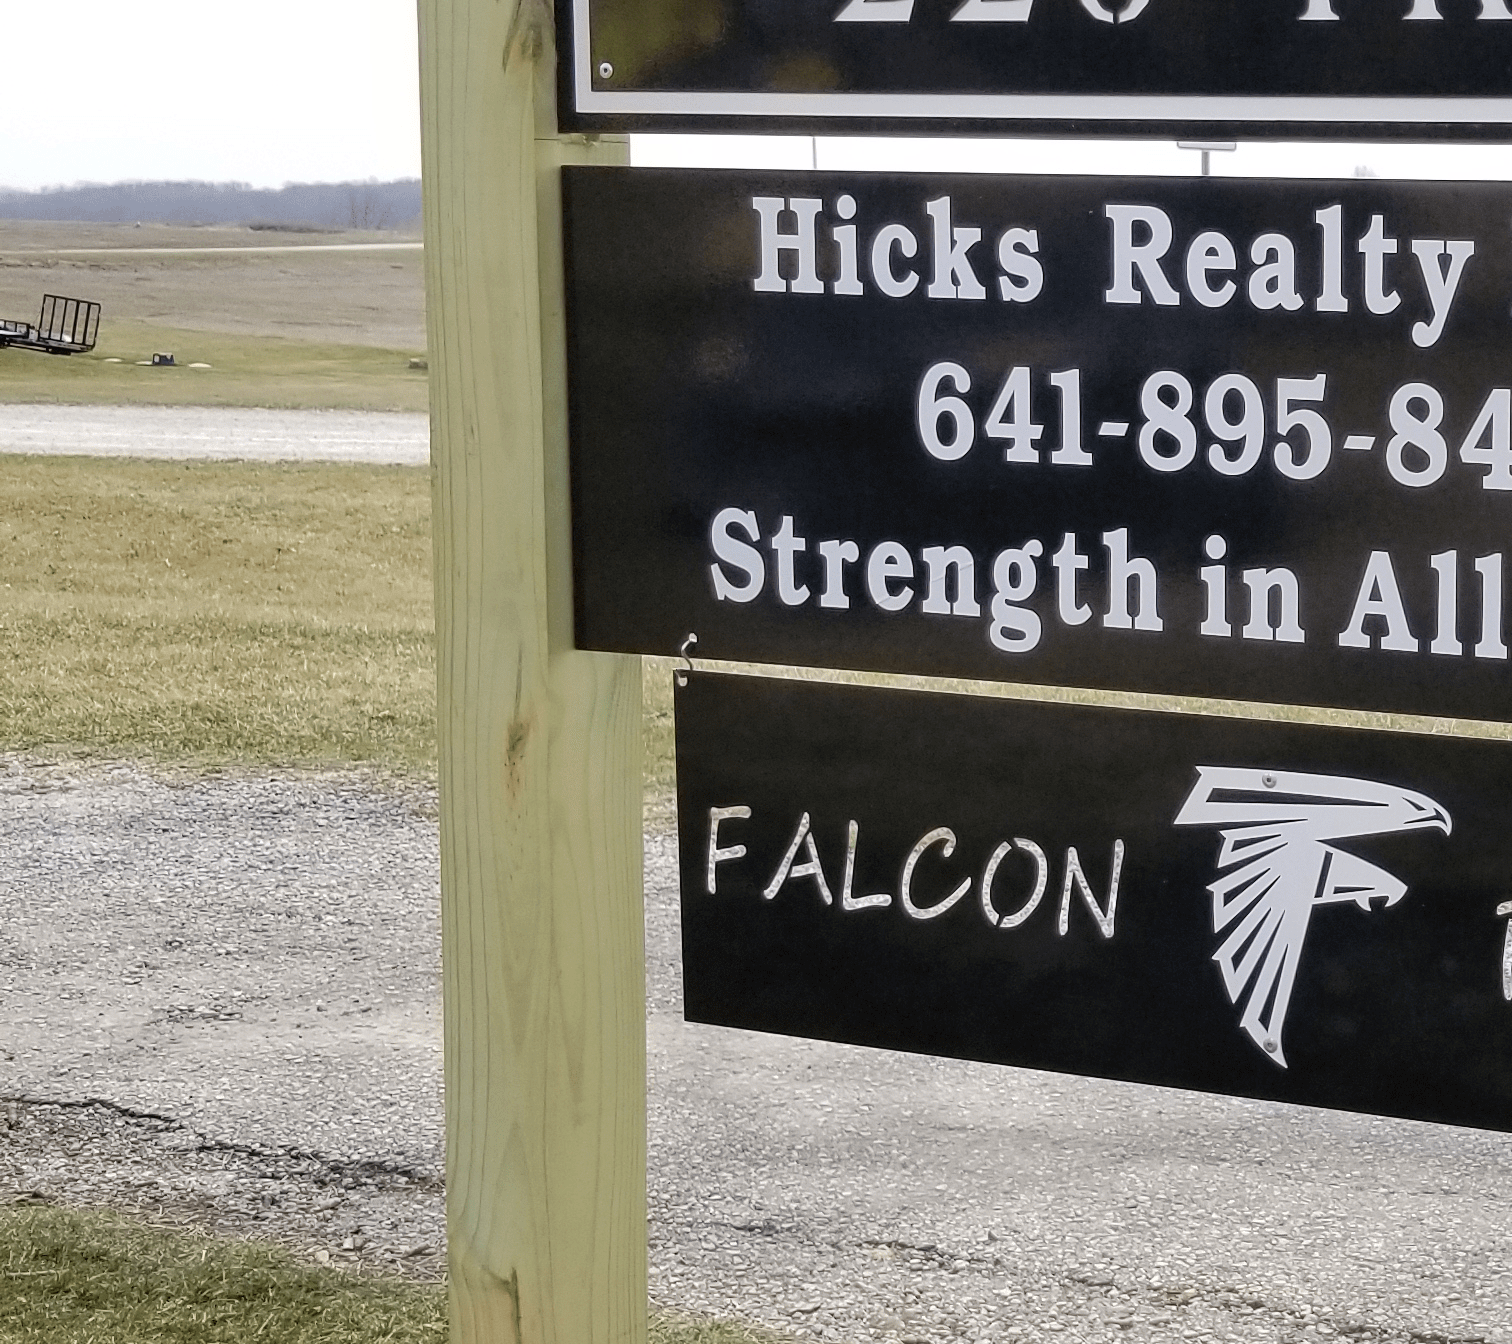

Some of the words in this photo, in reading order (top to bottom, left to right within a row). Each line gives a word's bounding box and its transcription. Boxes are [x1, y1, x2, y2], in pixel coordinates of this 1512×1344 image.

[751, 193, 1045, 304] Hicks
[1104, 203, 1476, 349] Realty
[709, 506, 1165, 654] Strength
[1199, 533, 1306, 645] in
[1337, 548, 1509, 661] All
[704, 803, 1126, 939] FALCON
